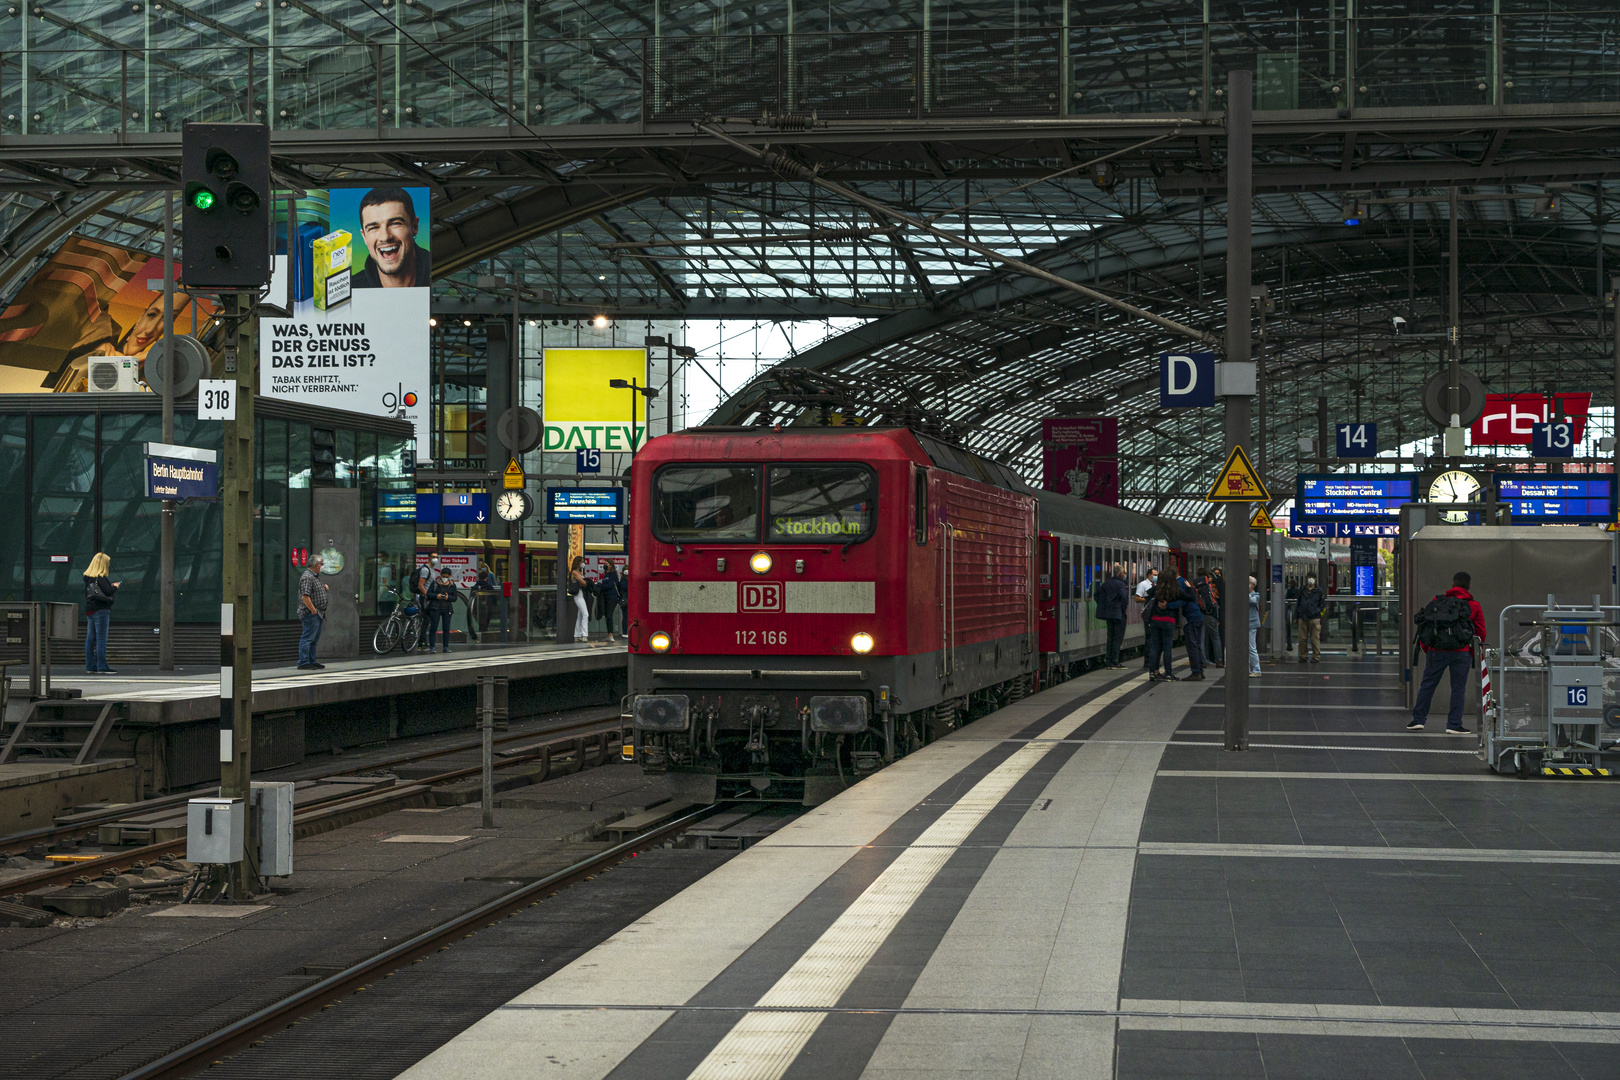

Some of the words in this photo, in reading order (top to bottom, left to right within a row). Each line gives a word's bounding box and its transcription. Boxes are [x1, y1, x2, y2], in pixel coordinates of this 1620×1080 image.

[332, 248, 344, 258] neo
[329, 275, 349, 288] Rauchen
[272, 324, 313, 339] WAS,
[317, 323, 365, 336] WENN
[272, 340, 303, 352] DER
[306, 339, 370, 352] GENUSS
[272, 355, 304, 368] DAS
[308, 354, 339, 368] ZIEL
[344, 353, 376, 367] IST?
[303, 375, 341, 384] ERHITZT,
[1168, 356, 1197, 395] D
[205, 390, 229, 409] 318
[544, 426, 645, 450] DATEV
[1340, 425, 1368, 448] 14
[1542, 424, 1570, 448] 13
[580, 450, 599, 466] 15
[153, 462, 168, 478] Berlin
[169, 465, 204, 482] Hauptbahnhof
[776, 518, 860, 534] Stockholm
[746, 587, 777, 608] DB
[735, 631, 756, 644] 112
[762, 631, 787, 644] 166
[1568, 688, 1586, 703] 16
